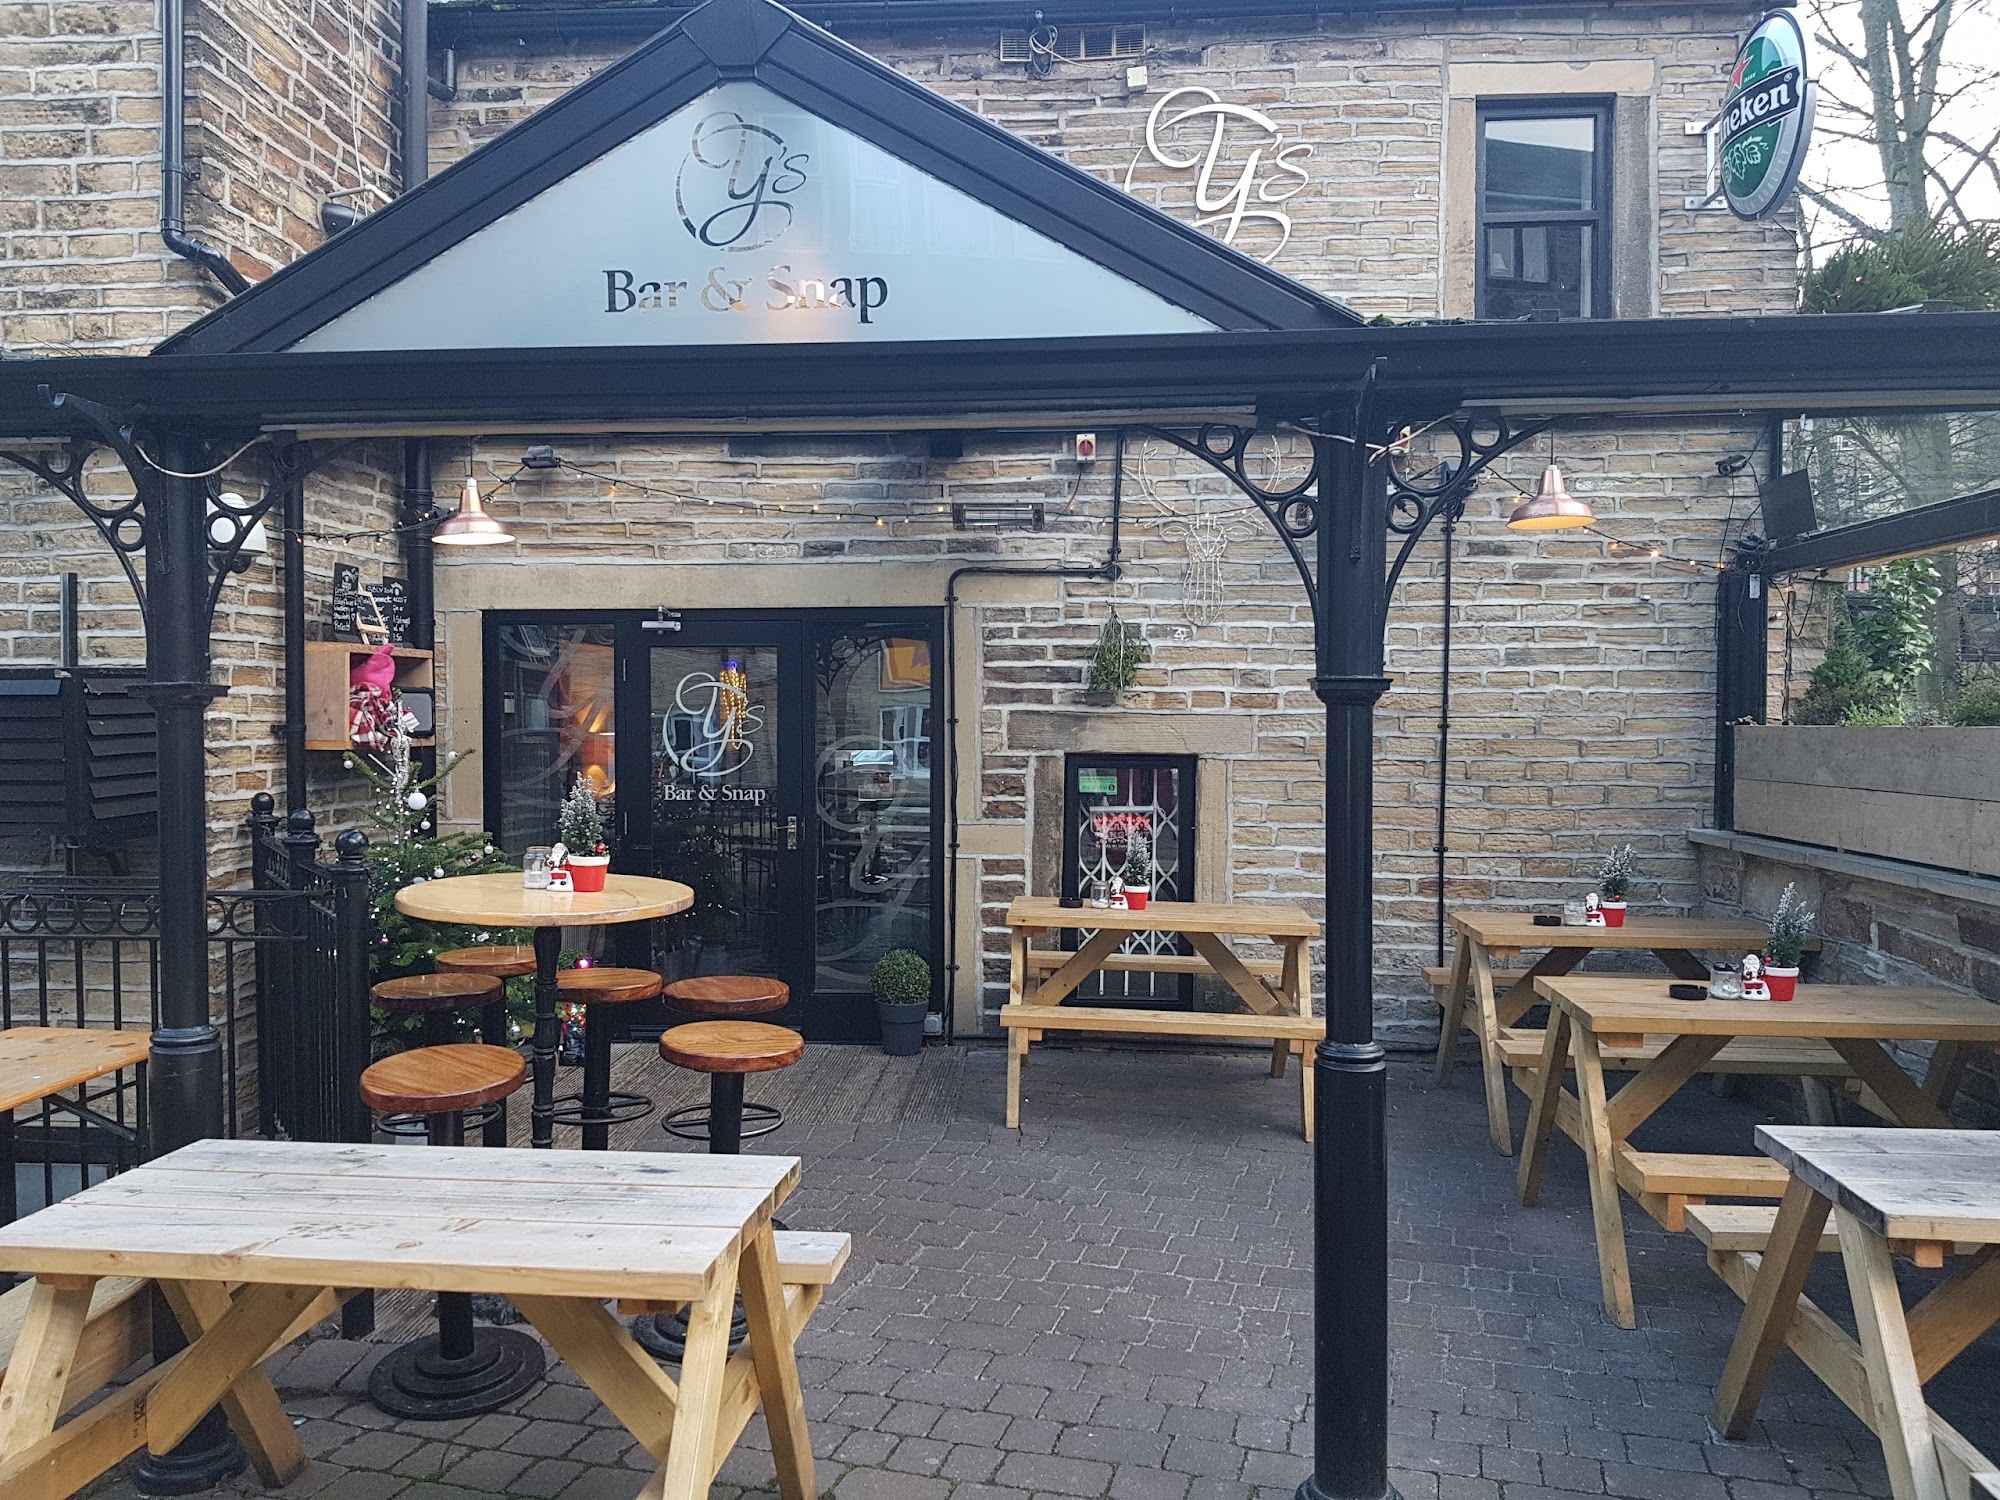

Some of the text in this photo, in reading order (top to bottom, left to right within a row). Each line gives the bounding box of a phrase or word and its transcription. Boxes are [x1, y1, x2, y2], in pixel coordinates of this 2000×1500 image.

[602, 265, 888, 324] Bar & Snap
[664, 784, 766, 805] Bar & Snap
